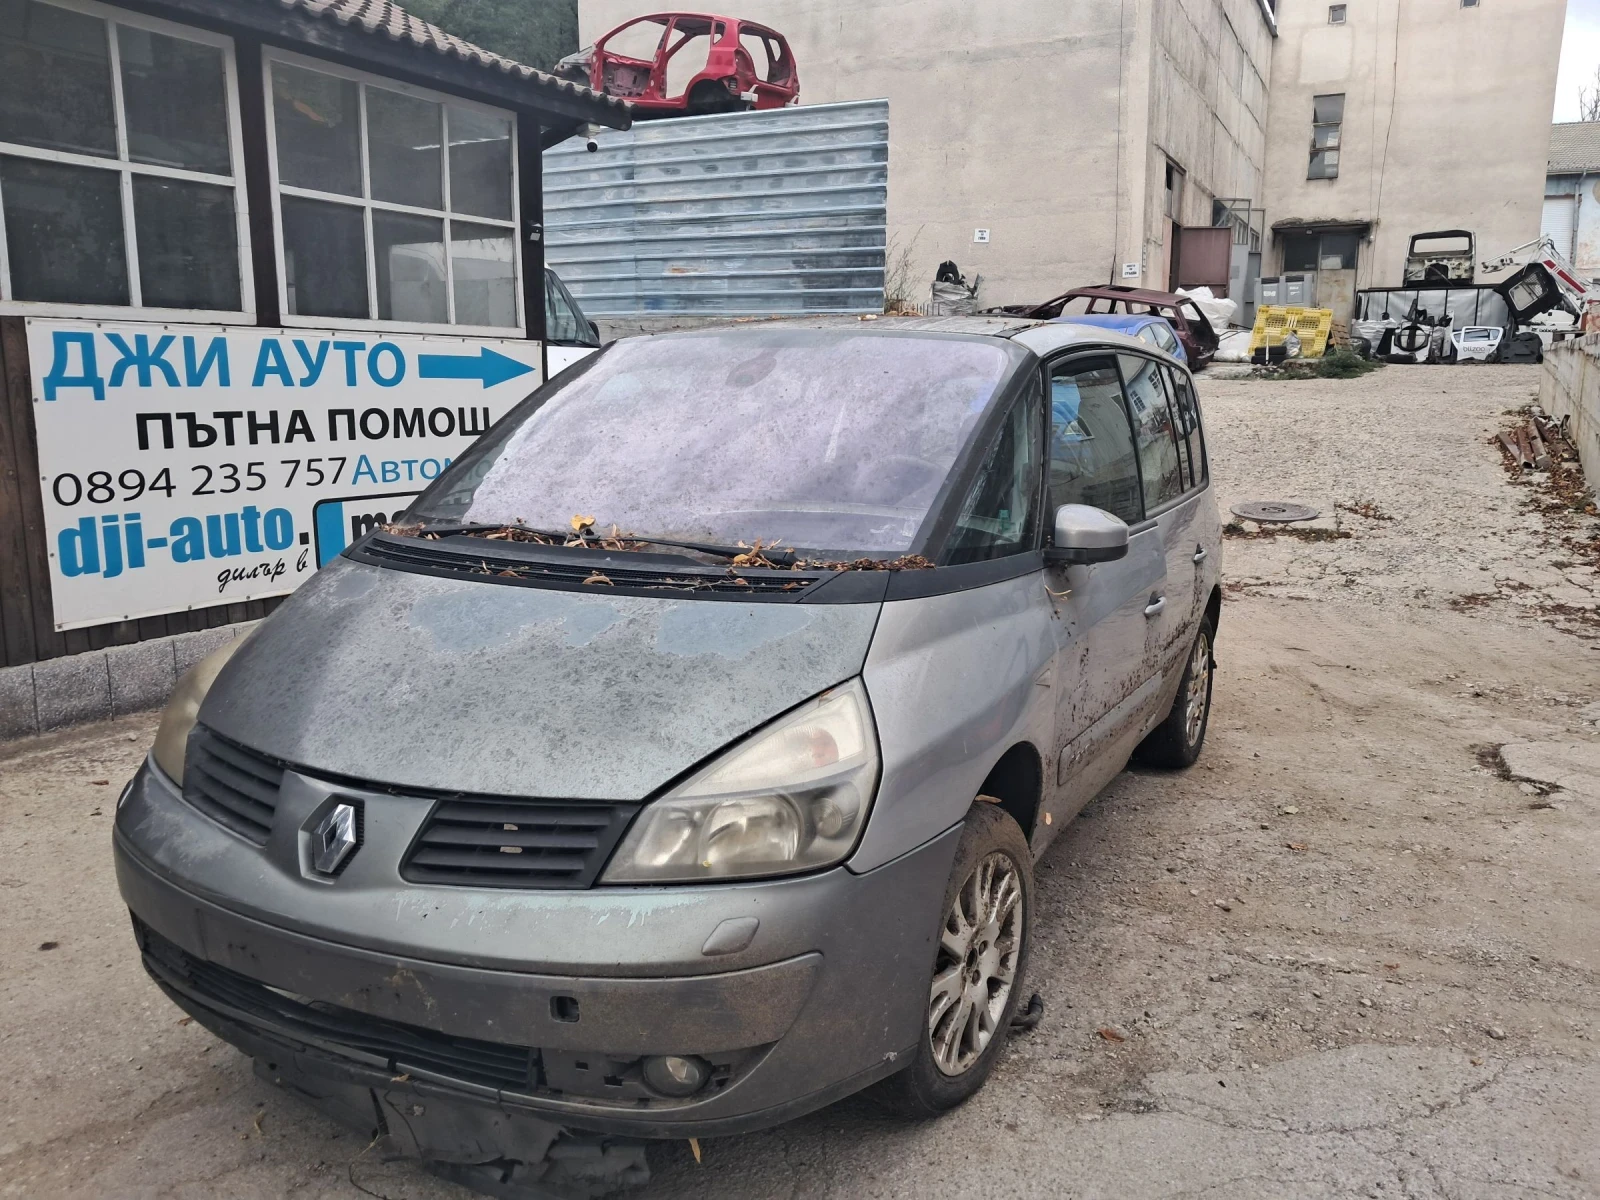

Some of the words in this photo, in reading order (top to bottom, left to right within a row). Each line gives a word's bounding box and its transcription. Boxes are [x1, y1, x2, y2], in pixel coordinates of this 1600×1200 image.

[43, 331, 231, 402] ДЖИ
[251, 339, 406, 389] АУТО
[135, 409, 316, 451] ПЪТНА
[52, 467, 177, 507] 0894
[191, 463, 267, 496] 235
[281, 456, 347, 489] 757
